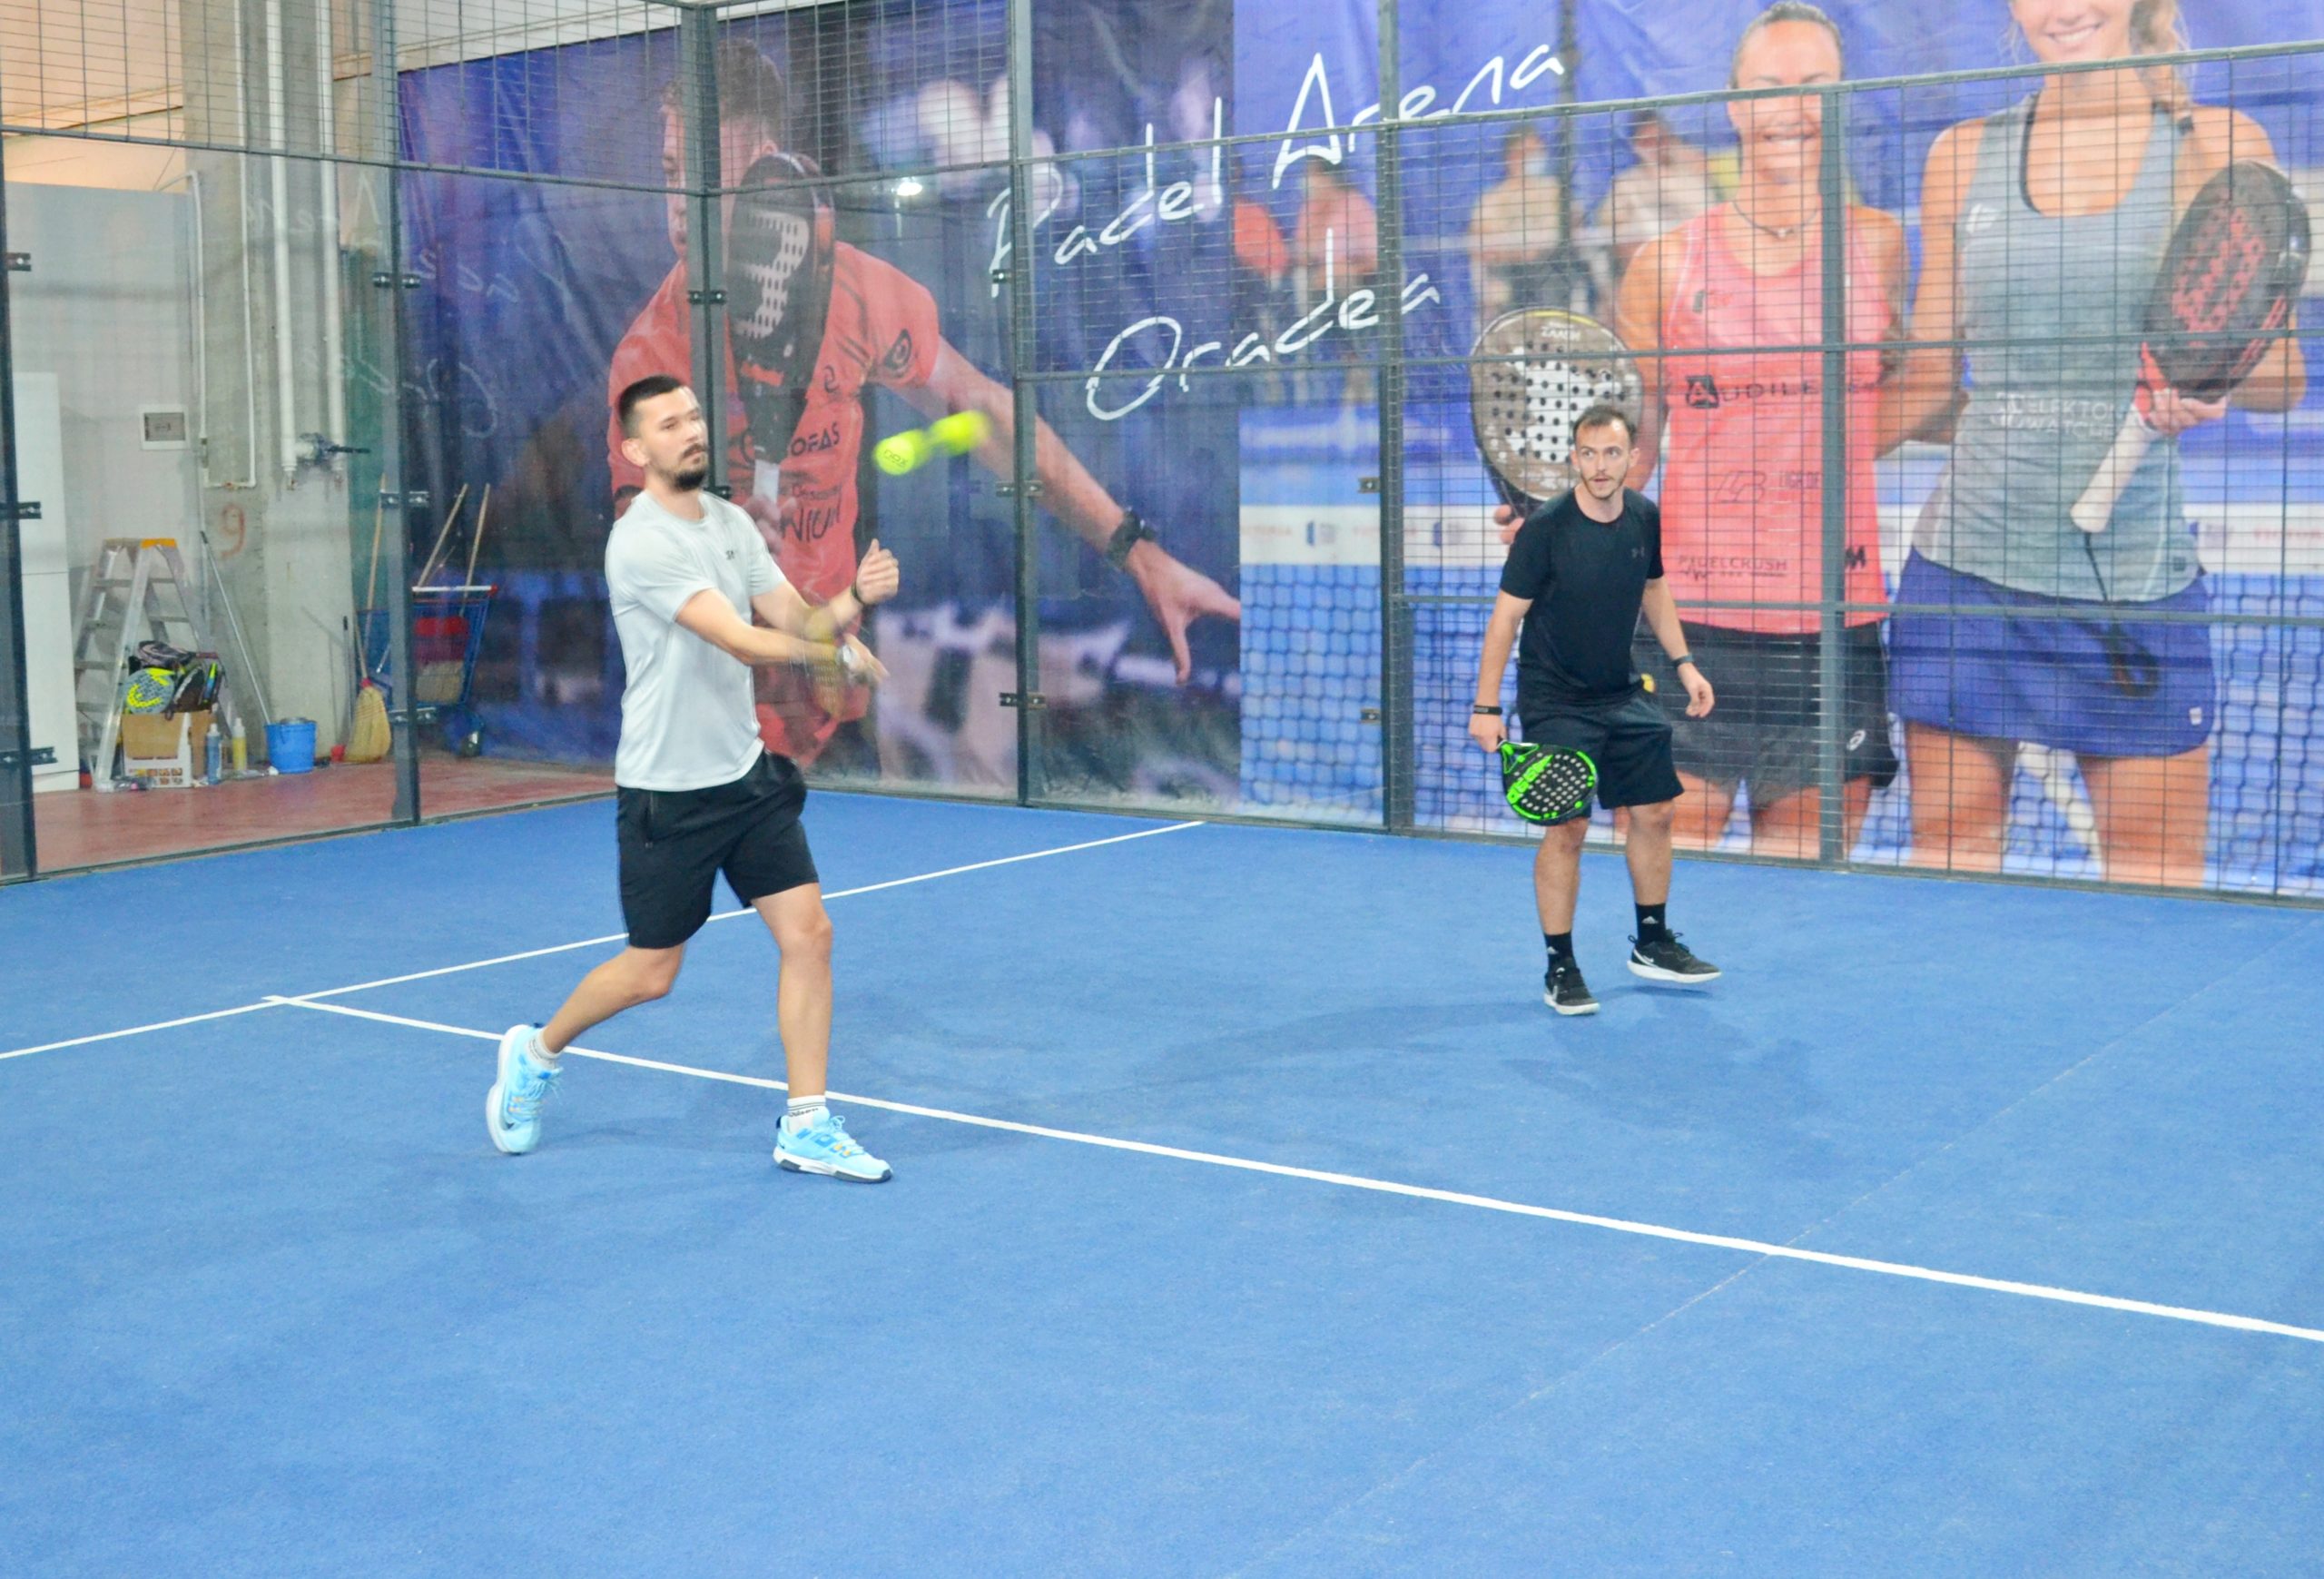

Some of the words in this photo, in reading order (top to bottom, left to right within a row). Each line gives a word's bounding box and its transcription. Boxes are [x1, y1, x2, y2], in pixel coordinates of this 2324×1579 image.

[986, 96, 1223, 298] Padel
[1271, 44, 1565, 190] Arena
[1085, 227, 1441, 420] Oradea
